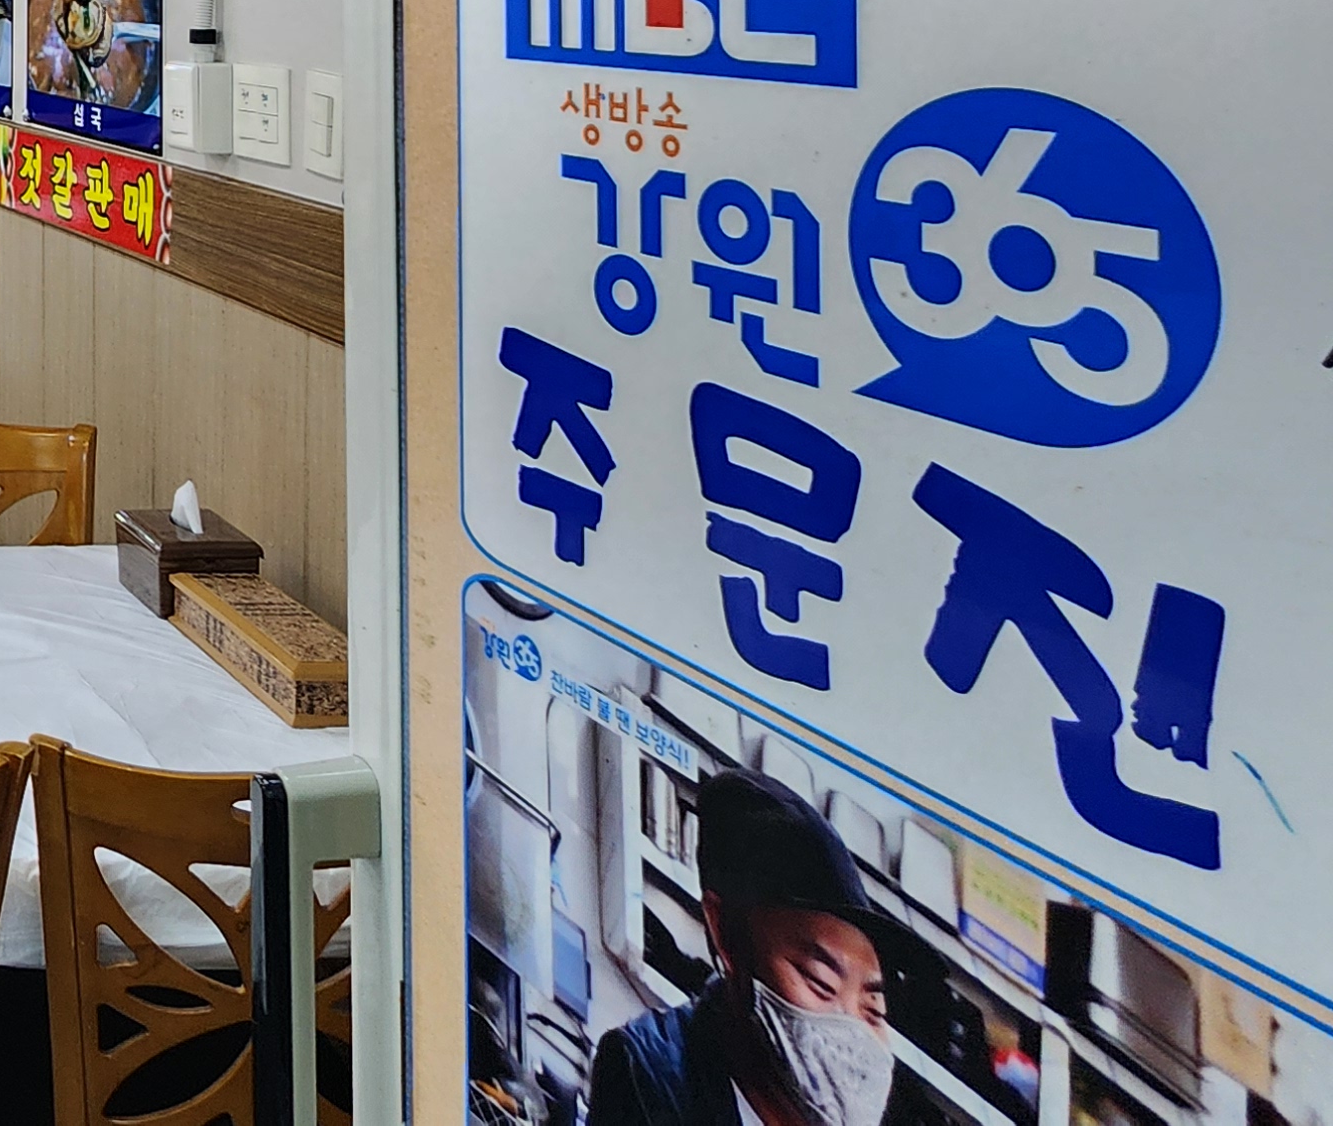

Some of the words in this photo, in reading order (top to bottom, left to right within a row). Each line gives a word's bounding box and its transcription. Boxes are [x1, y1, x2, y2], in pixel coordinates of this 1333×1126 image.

[561, 83, 687, 157] 생방송
[561, 154, 820, 388] 강원
[870, 128, 1169, 407] 365
[480, 626, 511, 670] 강원
[550, 669, 592, 711] 찬바람
[597, 697, 611, 723] 불
[615, 707, 631, 736] 땐
[635, 721, 690, 770] 보양식!
